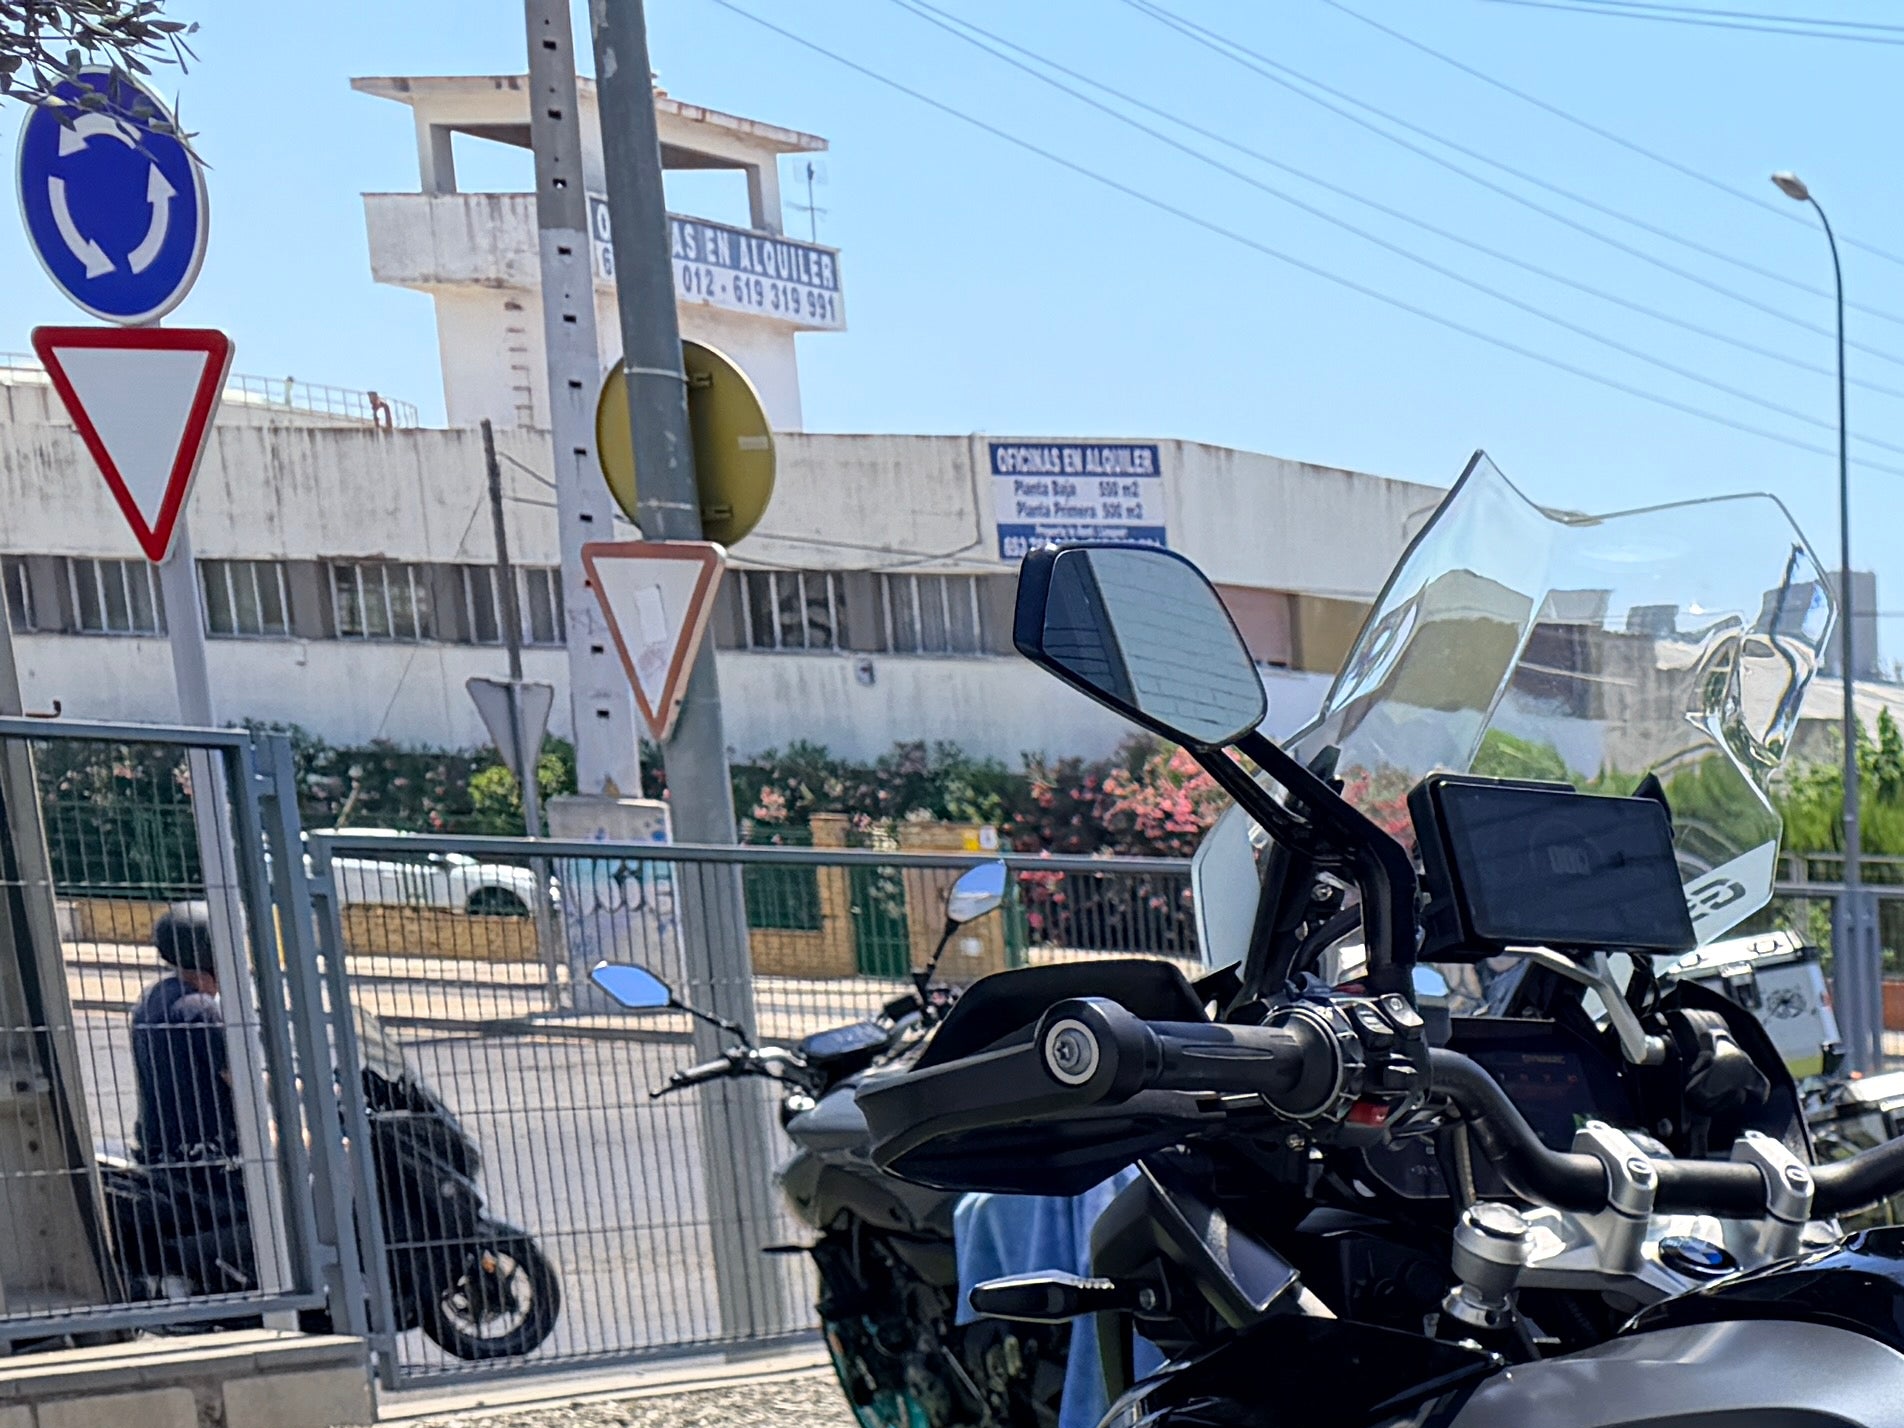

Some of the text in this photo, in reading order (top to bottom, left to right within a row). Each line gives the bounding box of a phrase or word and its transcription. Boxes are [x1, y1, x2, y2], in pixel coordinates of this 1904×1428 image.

[704, 227, 731, 267] EN
[739, 233, 834, 289] ALQUILER
[682, 264, 714, 298] 012
[732, 274, 764, 308] 619
[770, 281, 801, 315] 319
[807, 290, 836, 322] 991
[996, 447, 1154, 474] OFICINAS EN ALQUILER
